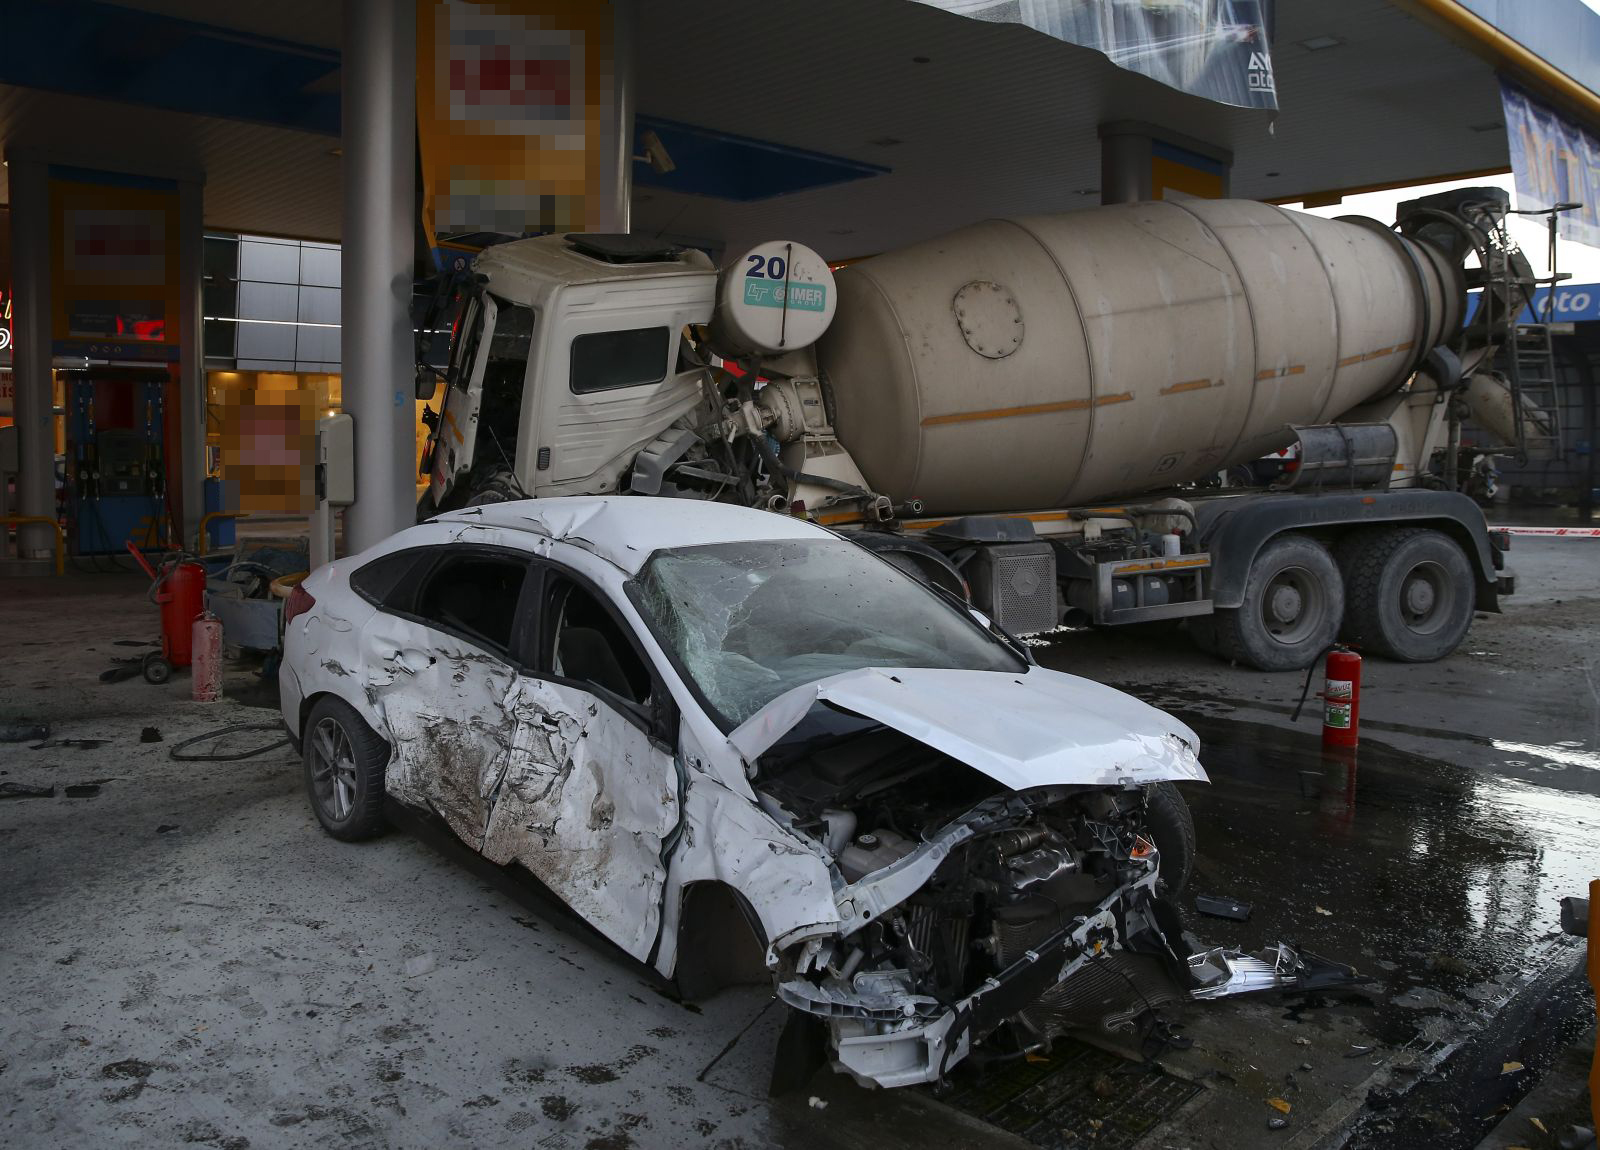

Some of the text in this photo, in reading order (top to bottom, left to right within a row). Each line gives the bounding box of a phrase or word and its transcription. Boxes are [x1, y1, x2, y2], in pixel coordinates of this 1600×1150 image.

[746, 255, 785, 280] 20
[791, 288, 822, 302] IMER
[1537, 291, 1591, 314] oto
